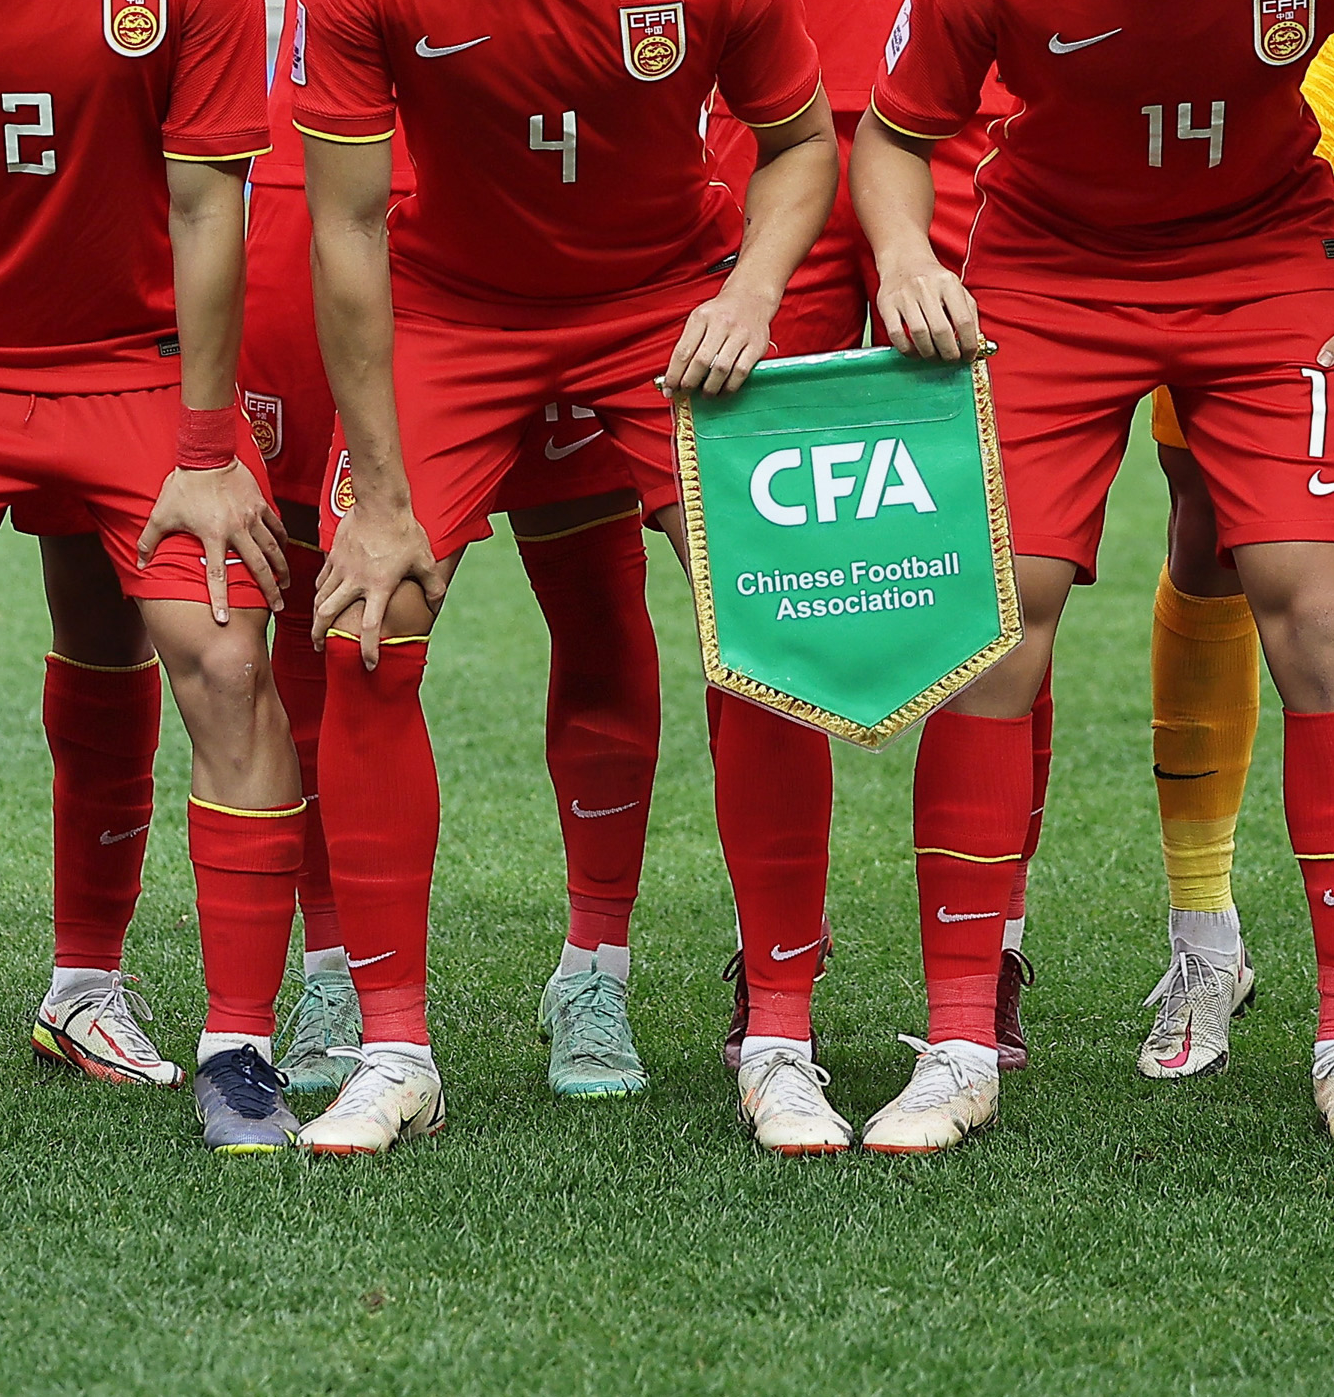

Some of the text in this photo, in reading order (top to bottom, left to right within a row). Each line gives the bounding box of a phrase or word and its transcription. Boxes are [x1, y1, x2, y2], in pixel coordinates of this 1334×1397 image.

[630, 10, 676, 28] CFA
[1, 92, 56, 176] 2
[528, 110, 577, 184] 4
[1140, 100, 1226, 169] 14
[248, 399, 276, 414] CFA
[749, 438, 938, 526] CFA
[736, 552, 960, 596] Chinese Football
[776, 585, 935, 621] Association
